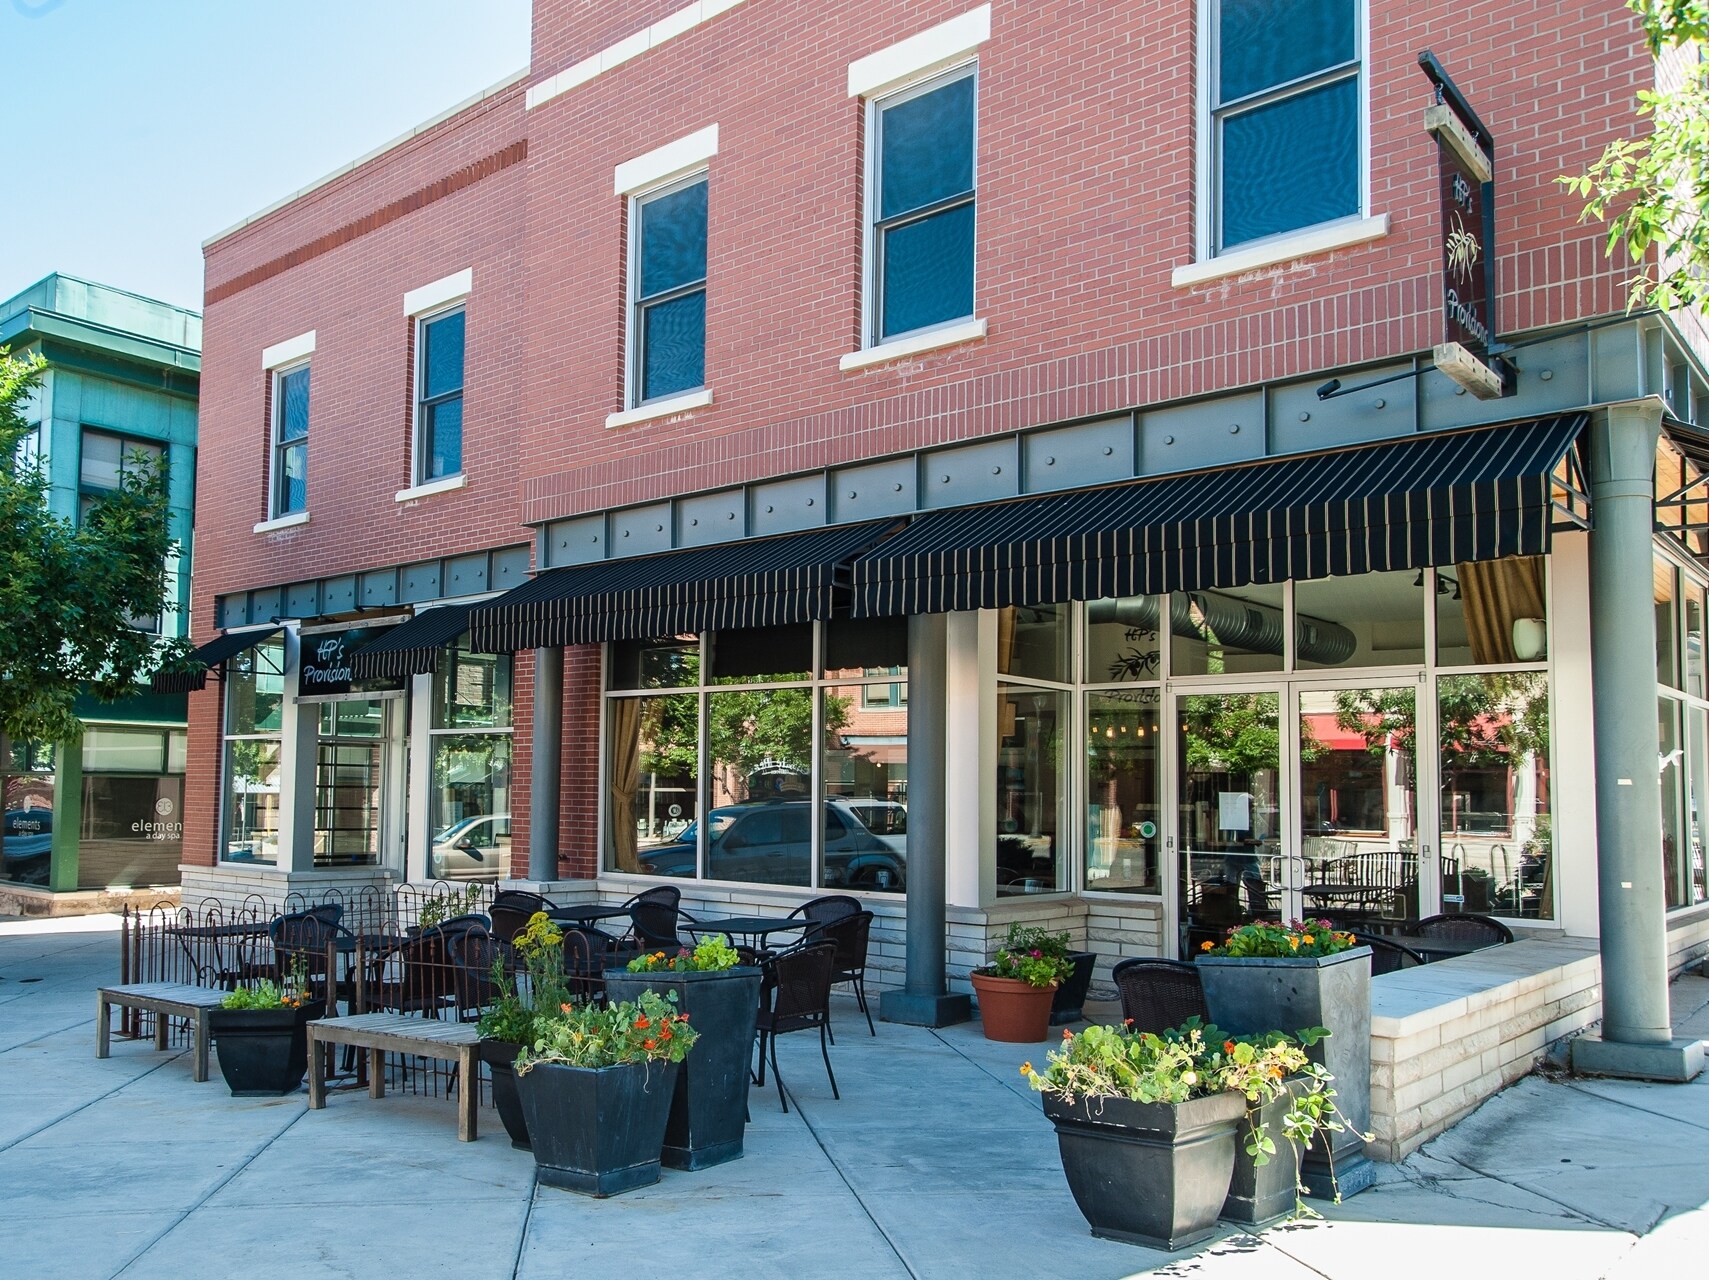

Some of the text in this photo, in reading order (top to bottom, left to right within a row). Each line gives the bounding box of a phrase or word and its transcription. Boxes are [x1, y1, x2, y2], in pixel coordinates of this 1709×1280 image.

[317, 637, 345, 662] HP's
[303, 662, 353, 685] Provision
[131, 819, 184, 832] elemen
[152, 832, 166, 841] day
[167, 832, 180, 840] spa
